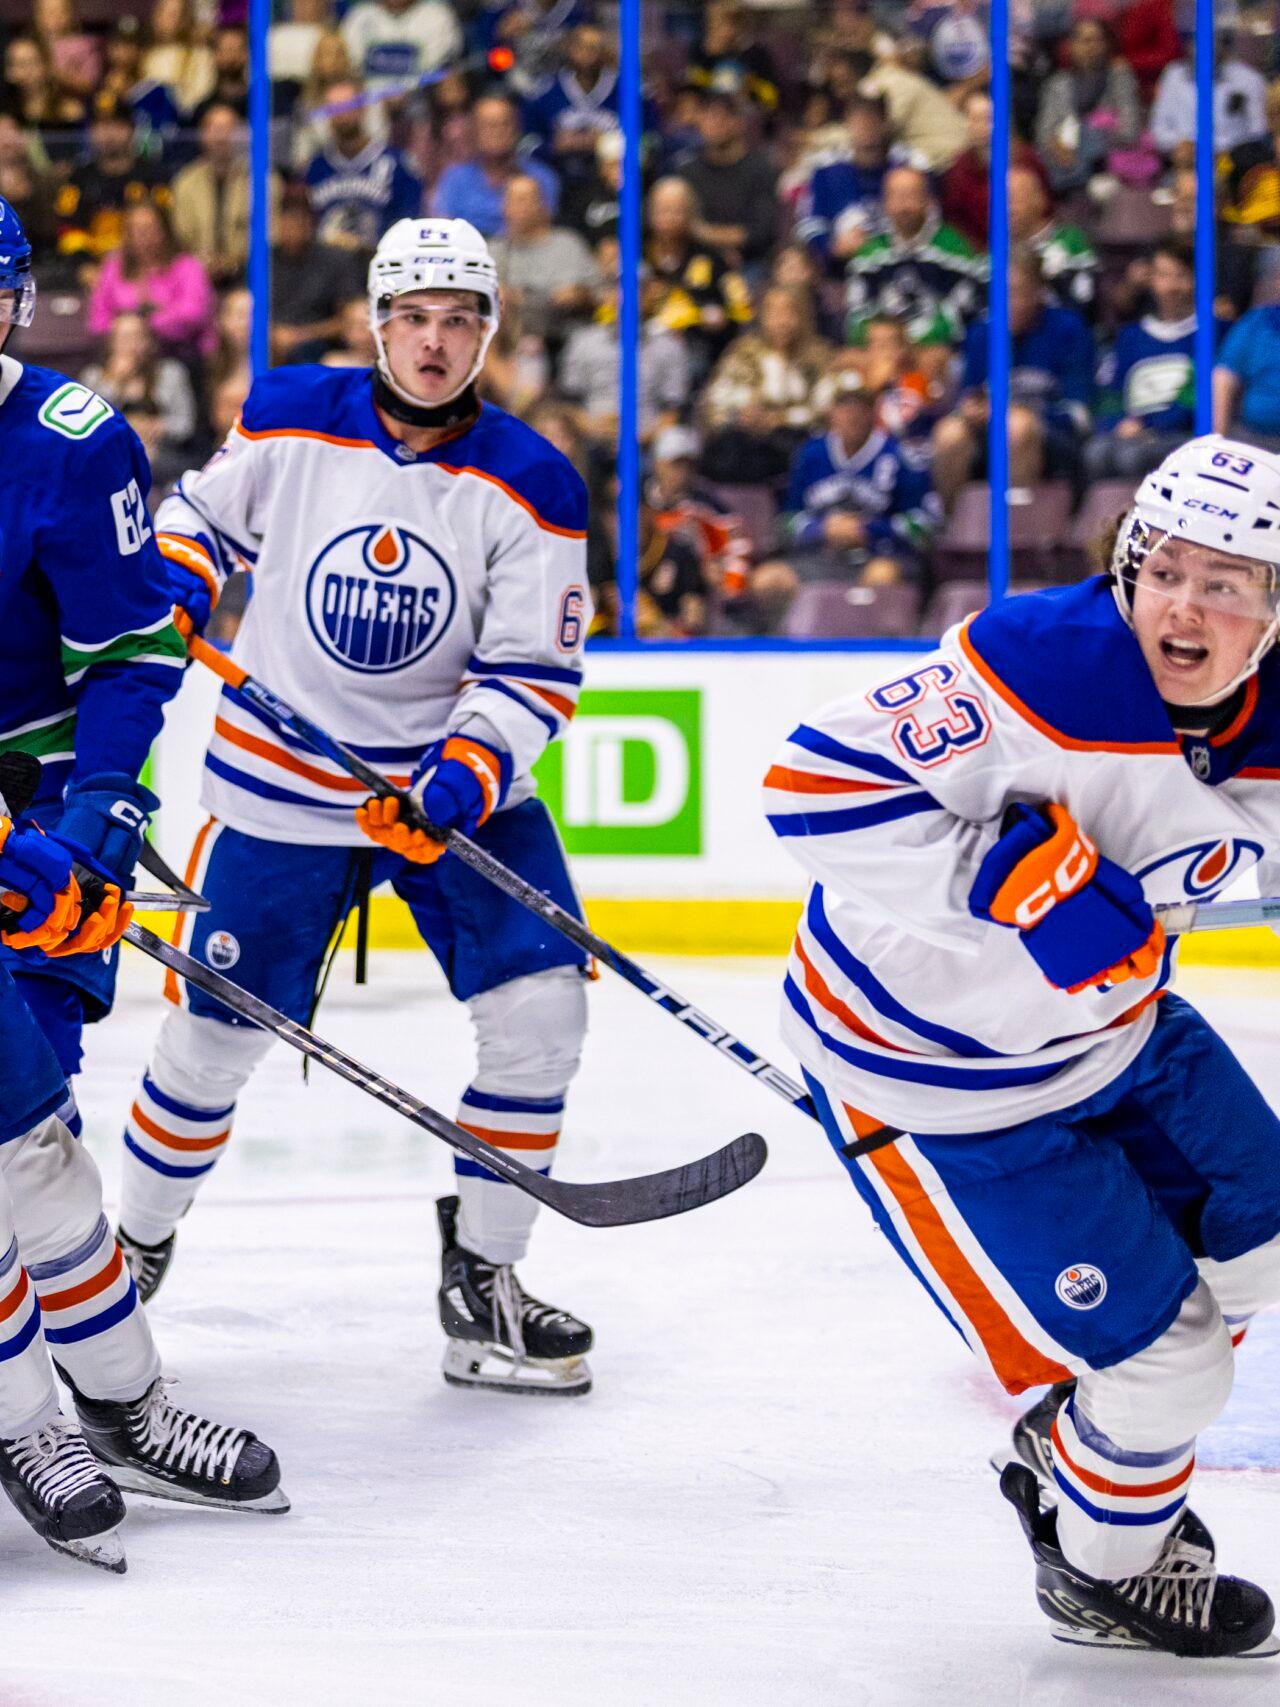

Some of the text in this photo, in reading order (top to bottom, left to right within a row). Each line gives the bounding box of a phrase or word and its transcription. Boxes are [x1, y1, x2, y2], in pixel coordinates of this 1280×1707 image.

[1212, 452, 1254, 476] 63
[110, 478, 152, 556] 62
[1183, 498, 1239, 520] CCM
[322, 573, 439, 632] OILERS
[865, 661, 992, 770] 63
[641, 970, 807, 1101] TRUE
[1064, 1274, 1100, 1300] OILERS
